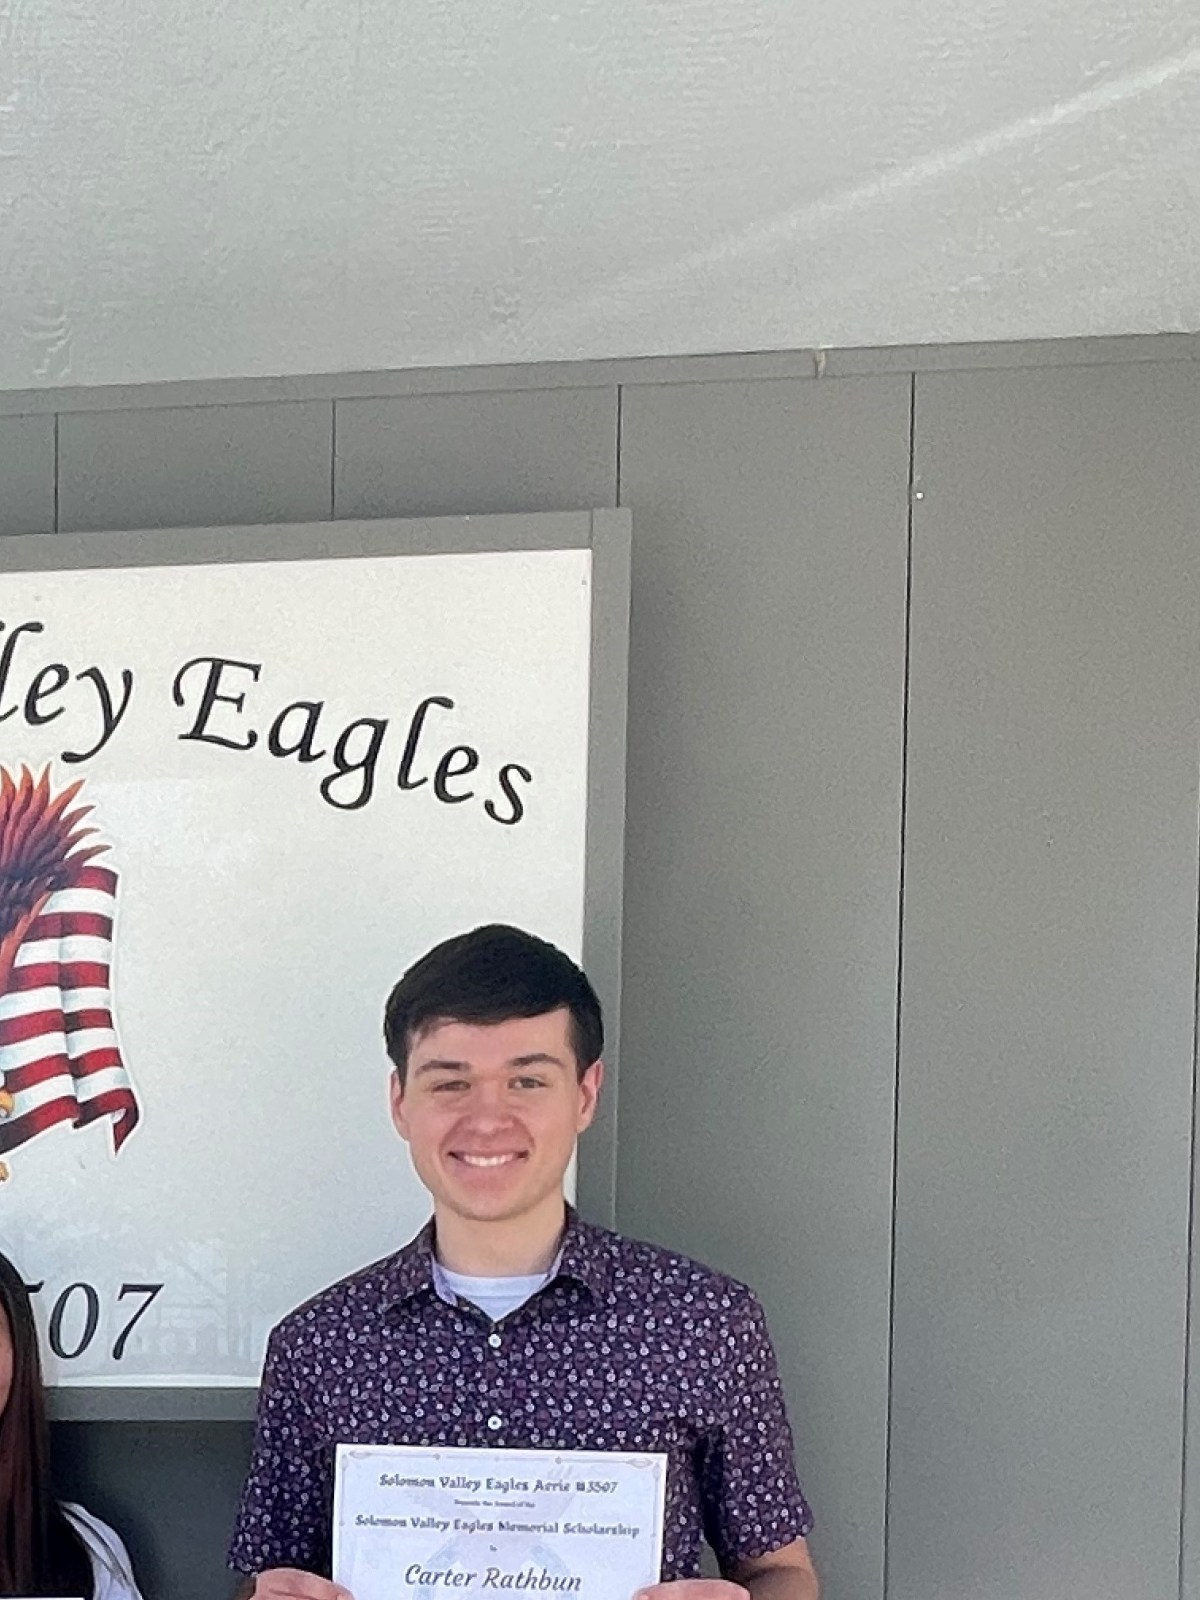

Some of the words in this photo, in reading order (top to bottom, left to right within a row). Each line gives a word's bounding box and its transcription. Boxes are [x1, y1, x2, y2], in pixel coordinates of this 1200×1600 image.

[172, 657, 532, 825] Eagles
[379, 1473, 435, 1488] Solomon
[439, 1476, 481, 1492] Valley
[485, 1477, 529, 1493] Eagles
[534, 1479, 570, 1492] Aerie
[355, 1514, 408, 1528] Solomon
[411, 1516, 450, 1532] Valley
[454, 1518, 494, 1534] Eagles
[498, 1520, 559, 1534] Memorial
[563, 1522, 640, 1539] Scholarship
[404, 1563, 477, 1587] Carter
[481, 1566, 582, 1592] Rathbun
